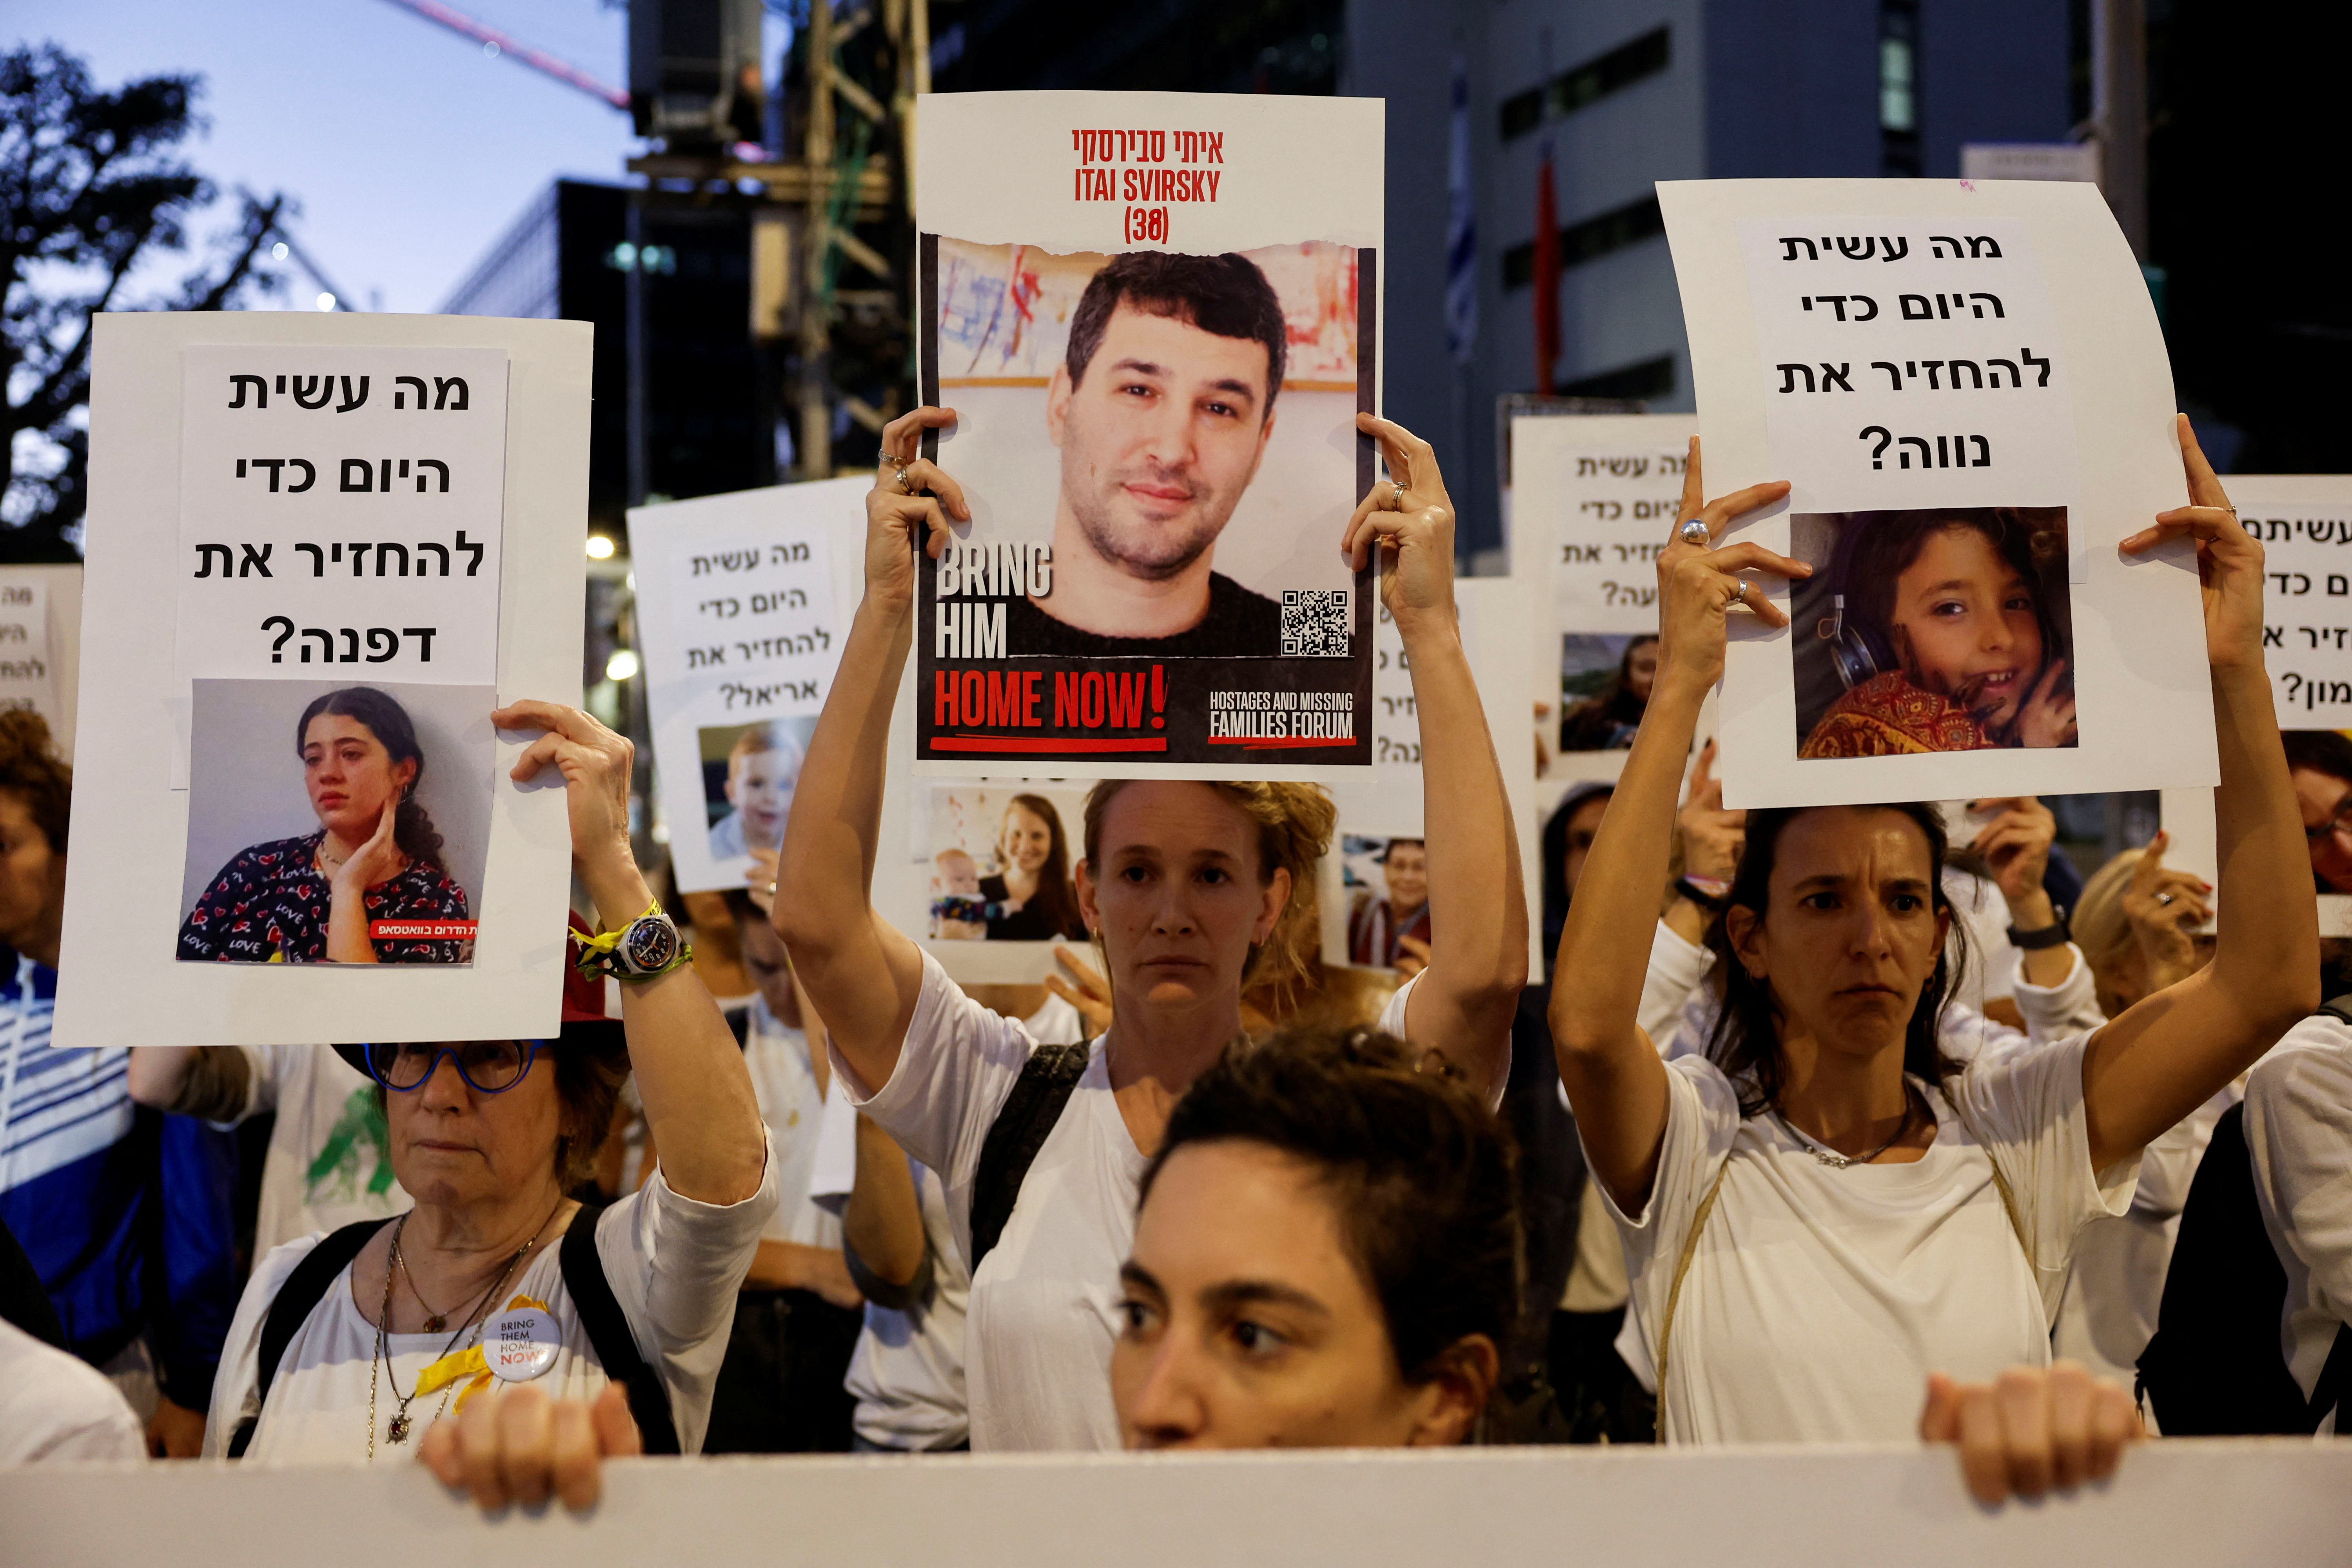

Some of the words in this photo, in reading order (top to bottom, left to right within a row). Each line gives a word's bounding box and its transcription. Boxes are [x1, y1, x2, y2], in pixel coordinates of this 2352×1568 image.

[1072, 129, 1165, 166] סבירסקי
[1174, 131, 1224, 164] איתי
[1075, 169, 1116, 201] ITAI
[1123, 169, 1221, 202] SVIRSKY
[1124, 206, 1169, 245] (38)
[1778, 236, 1909, 263] עשית
[1928, 236, 2003, 259] מה
[1801, 295, 1879, 322] כדי
[1898, 292, 2005, 320] היום
[1776, 362, 1855, 394] את
[1870, 347, 2051, 391] להחזיר
[227, 374, 370, 414] עשית
[394, 376, 469, 410] מה
[1858, 425, 1991, 470] נווה?
[236, 458, 316, 493] כדי
[339, 458, 450, 493] היום
[1578, 458, 1648, 478] עשית
[1581, 501, 1622, 520] כדי
[2241, 518, 2352, 546] עשיתם
[193, 543, 274, 579] את
[294, 530, 484, 577] להחזיר
[691, 549, 760, 576] עשית
[771, 542, 810, 565] מה
[1564, 545, 1601, 563] את
[1613, 544, 1666, 562] חזיר
[936, 539, 1051, 597] BRING
[1601, 581, 1657, 608] עה?
[2263, 573, 2311, 595] כד
[699, 597, 740, 618] כדי
[750, 588, 808, 615] היום
[260, 615, 437, 663] דפנה?
[736, 626, 831, 661] להחזיר
[935, 603, 1007, 659] HIM
[2263, 626, 2283, 647] א
[2299, 626, 2352, 648] זיר
[688, 647, 724, 668] את
[720, 681, 818, 708] אריאל?
[935, 670, 1043, 727] HOME
[1054, 664, 1169, 730] NOW!
[1210, 691, 1271, 711] HOSTAGES
[1273, 691, 1297, 711] AND
[1299, 692, 1354, 711] MISSING
[2281, 672, 2352, 710] מון?
[1379, 696, 1416, 717] זיר
[1210, 710, 1287, 739] FAMILIES
[1291, 711, 1353, 739] FORUM
[1378, 735, 1421, 763] נה?
[276, 903, 304, 924] LOVE
[183, 933, 212, 954] LOVE
[378, 926, 432, 935] בוואטסאפ
[434, 926, 467, 935] הדרום
[469, 926, 477, 935] ת
[229, 939, 261, 954] LOVE
[501, 1319, 535, 1331] BRING
[501, 1330, 530, 1341] THEM
[501, 1340, 534, 1353] HOME
